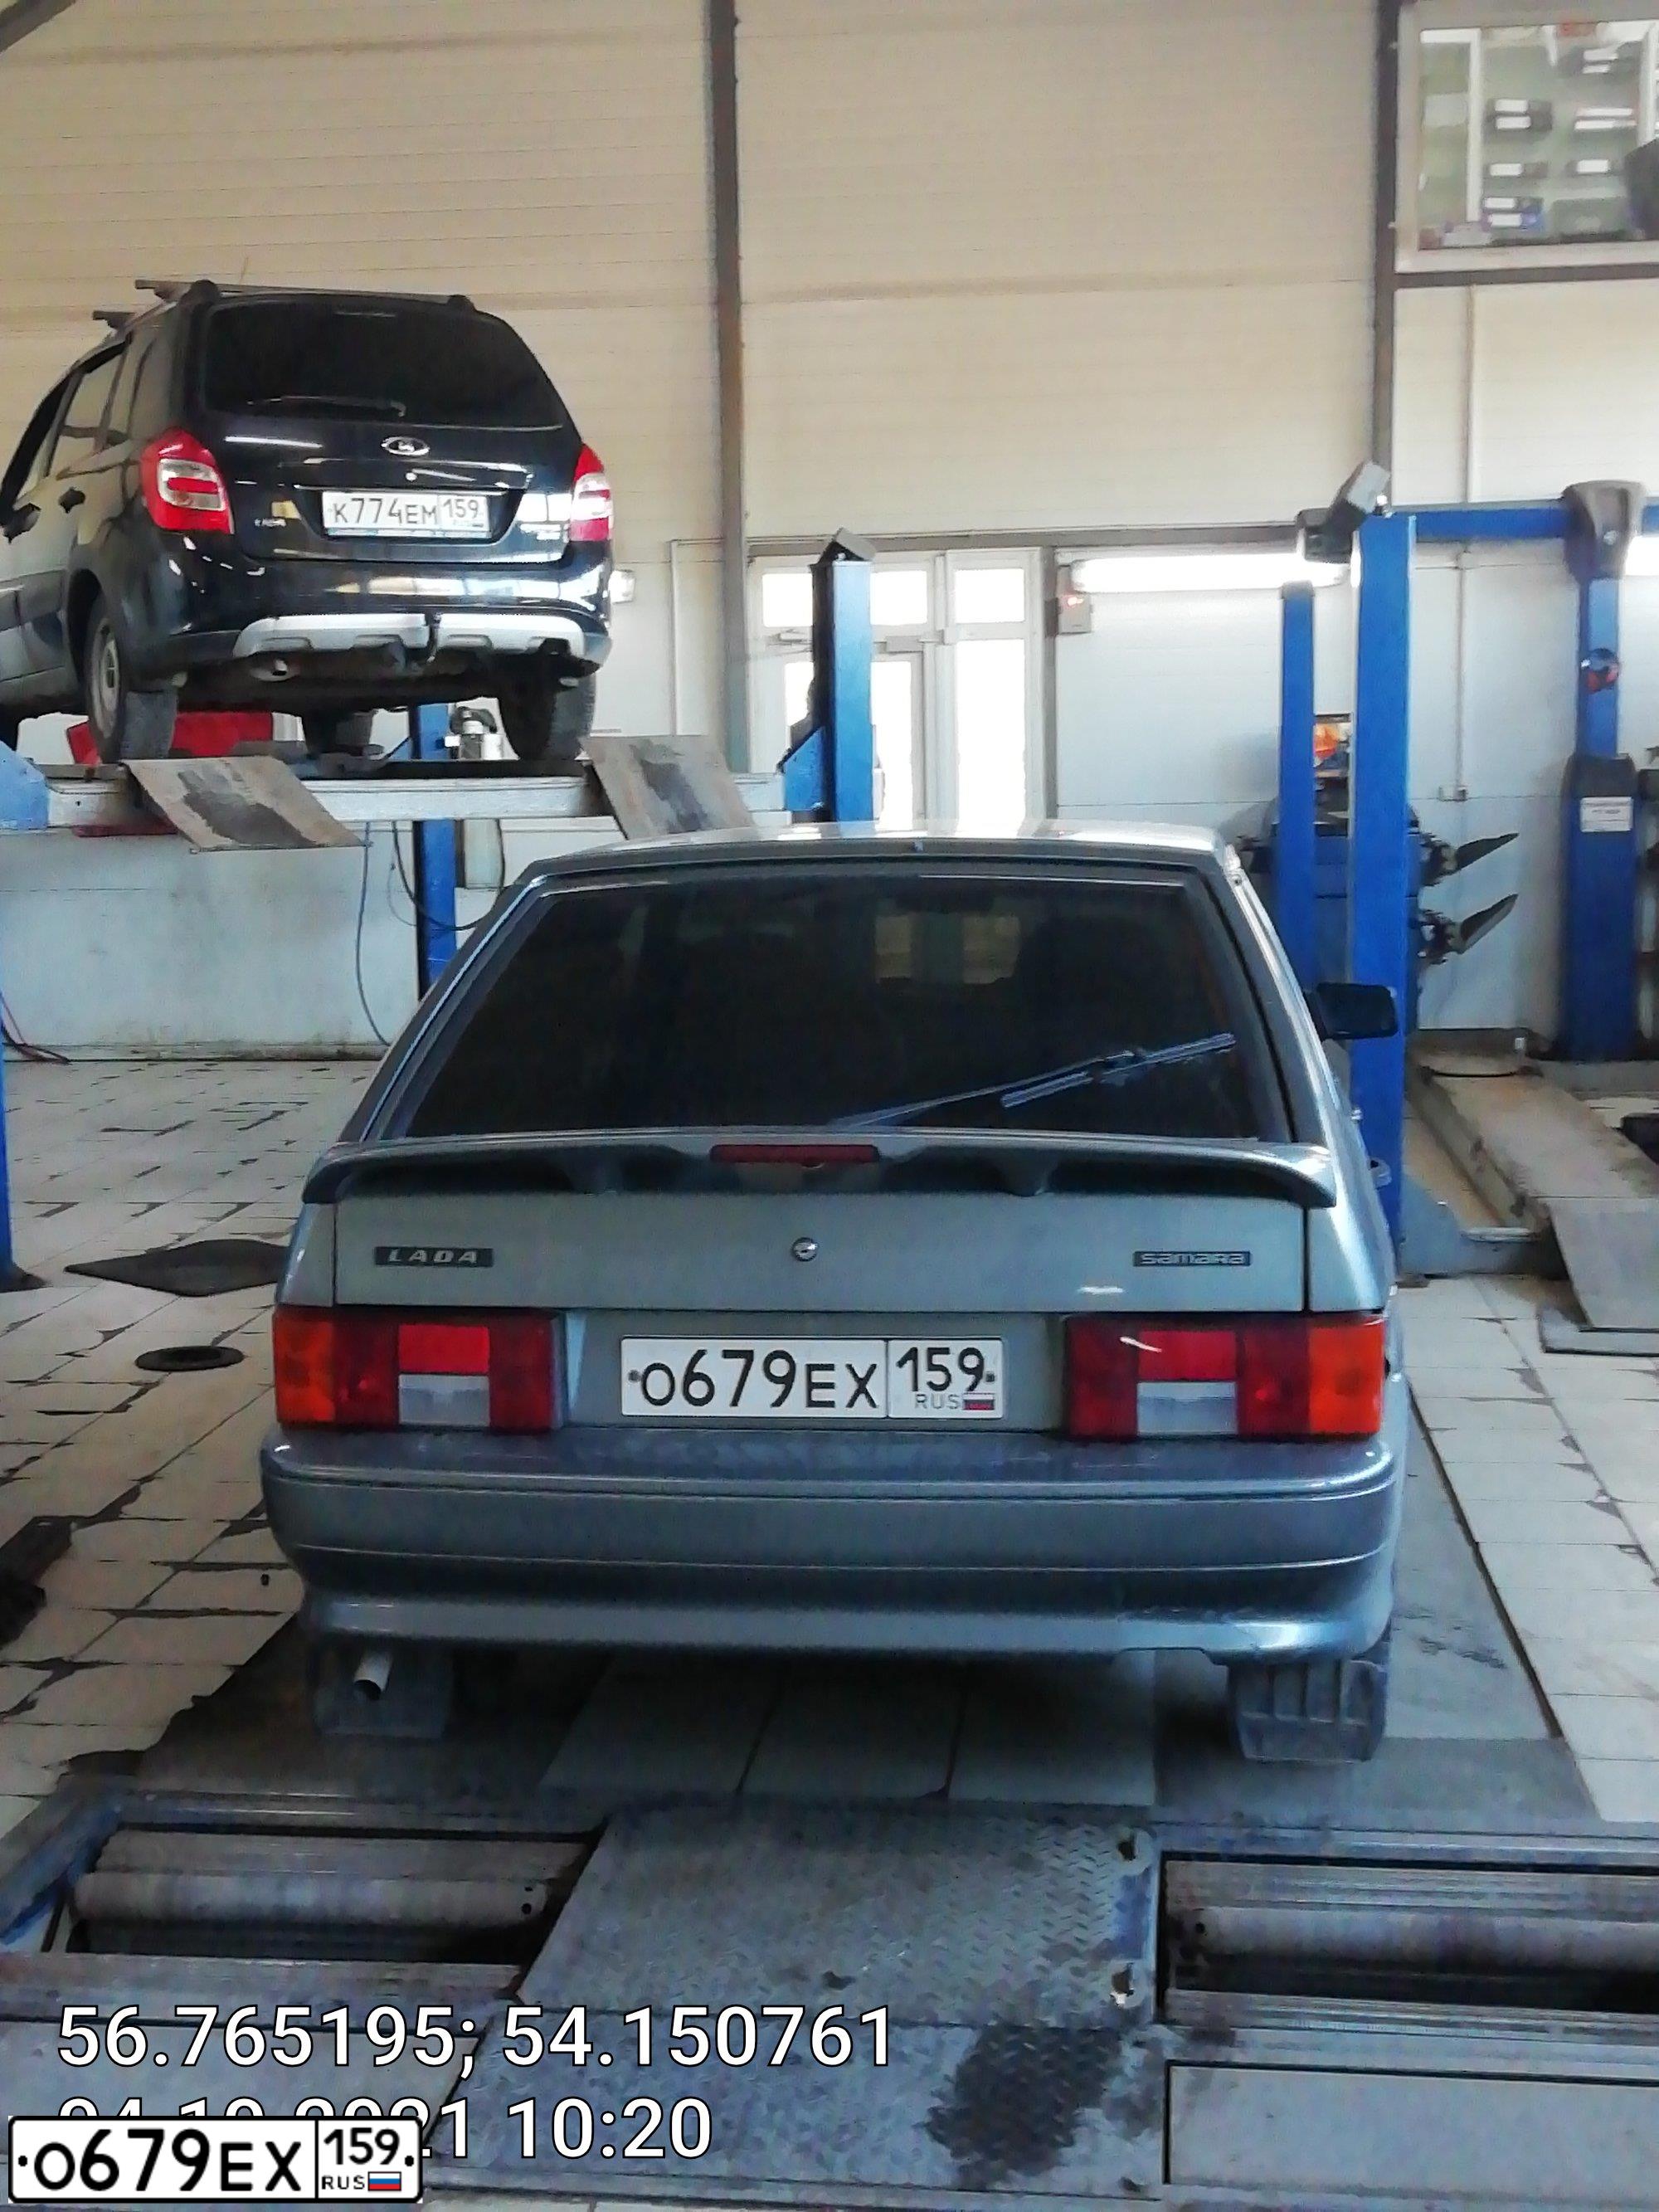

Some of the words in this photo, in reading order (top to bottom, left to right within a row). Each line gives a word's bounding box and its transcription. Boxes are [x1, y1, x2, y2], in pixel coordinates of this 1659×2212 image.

[443, 499, 479, 519] 159
[387, 1249, 477, 1264] LADA
[896, 1347, 985, 1392] 159
[915, 1394, 961, 1410] RUS
